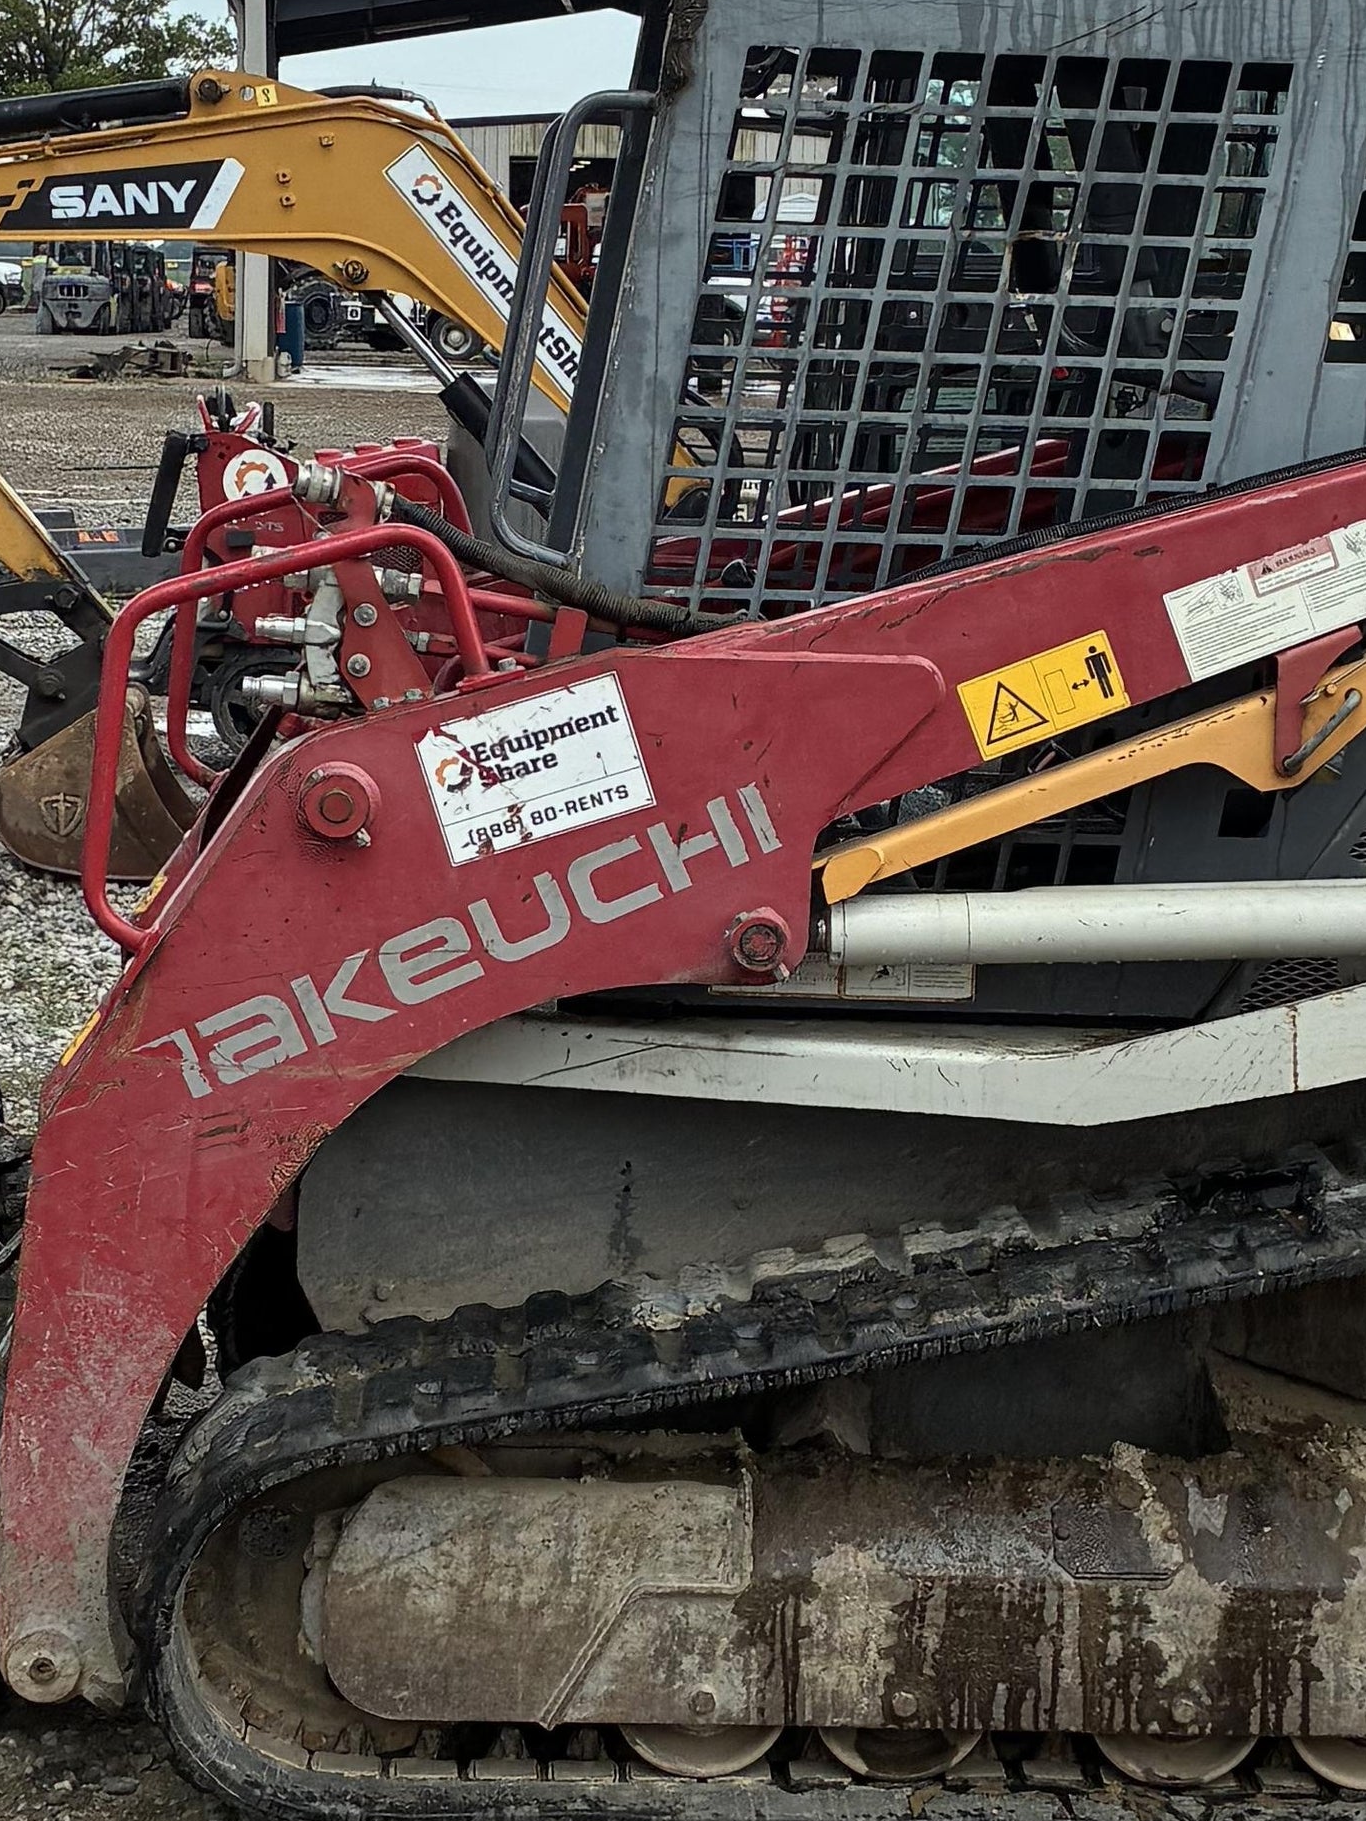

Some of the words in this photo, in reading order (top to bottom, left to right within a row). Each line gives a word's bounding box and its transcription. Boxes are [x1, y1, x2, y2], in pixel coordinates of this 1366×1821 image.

[50, 179, 197, 219] SANY
[471, 704, 621, 762] Equipment
[530, 784, 630, 826] 80-RENTS
